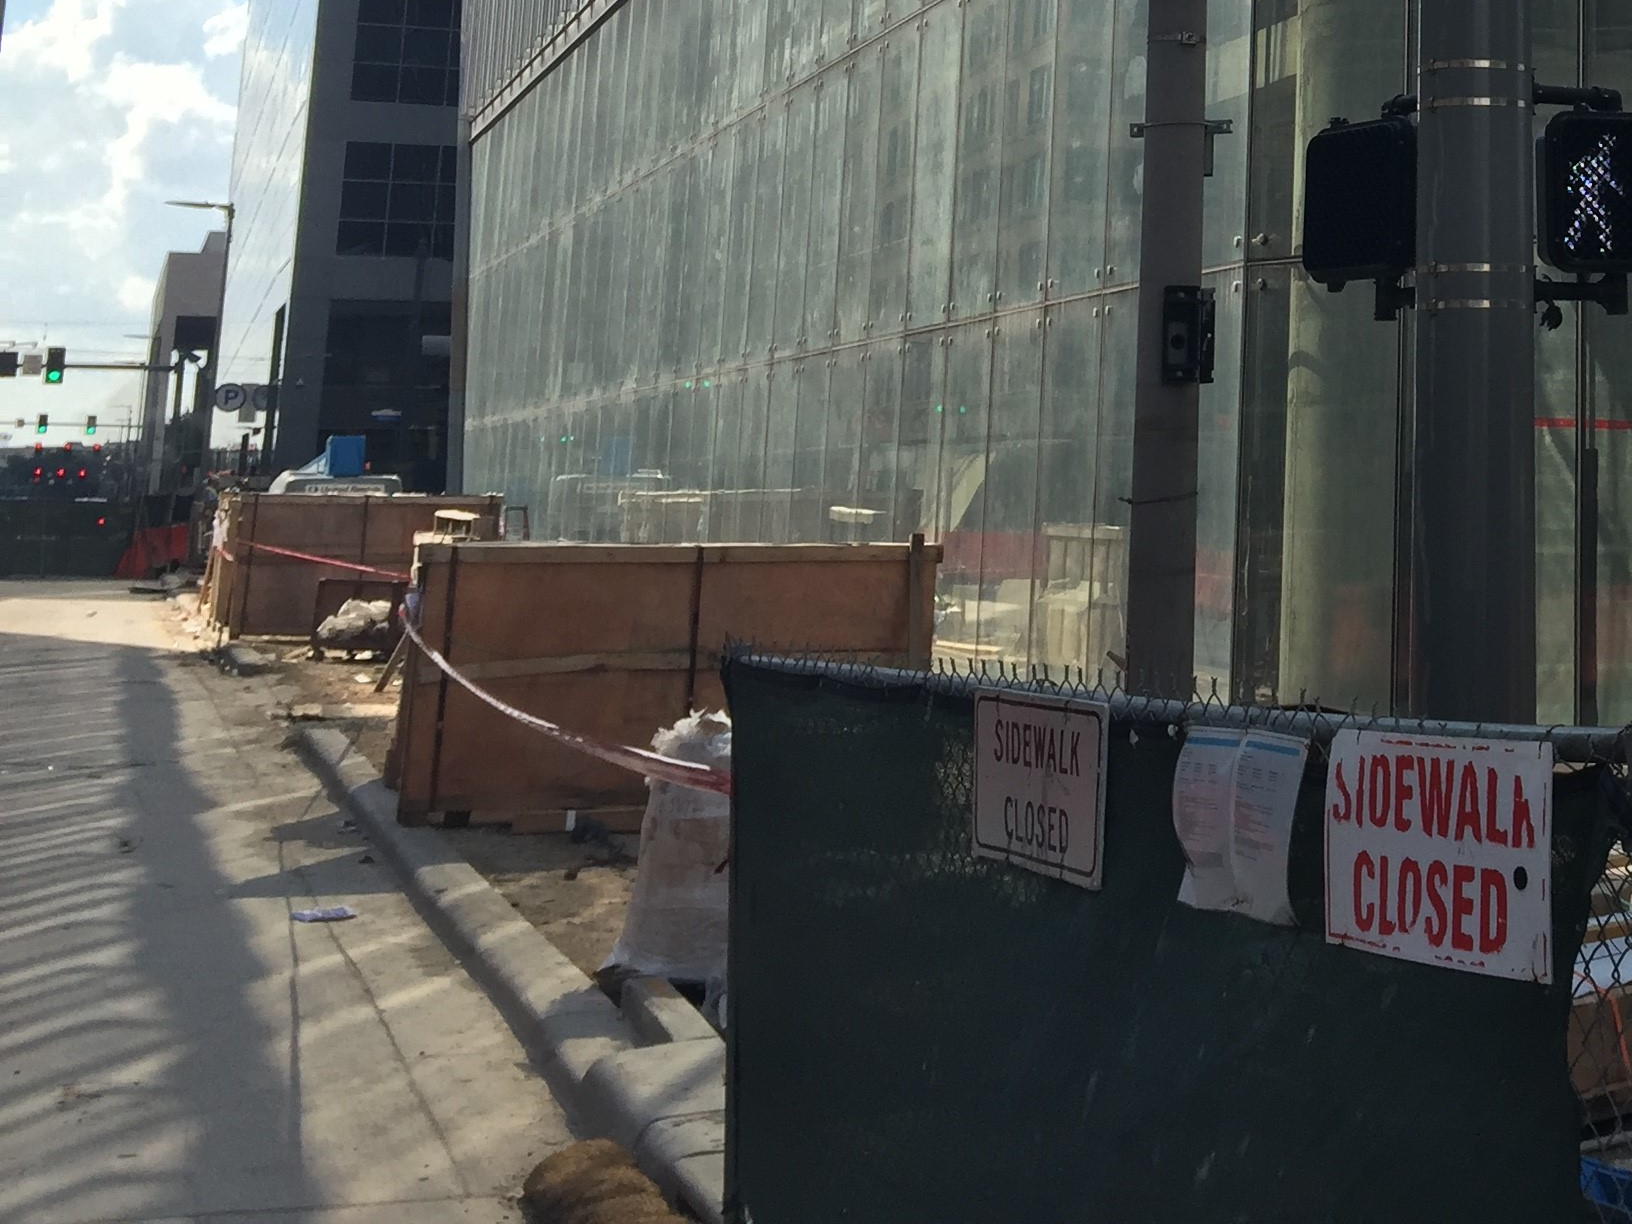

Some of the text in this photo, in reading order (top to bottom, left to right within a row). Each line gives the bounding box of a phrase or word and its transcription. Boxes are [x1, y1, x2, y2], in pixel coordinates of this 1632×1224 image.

[224, 389, 239, 406] P
[993, 718, 1080, 777] SIDEWALK
[1004, 795, 1069, 854] CLOSED
[1332, 753, 1535, 849] SIDEWALK
[1353, 849, 1508, 955] CLOSED
